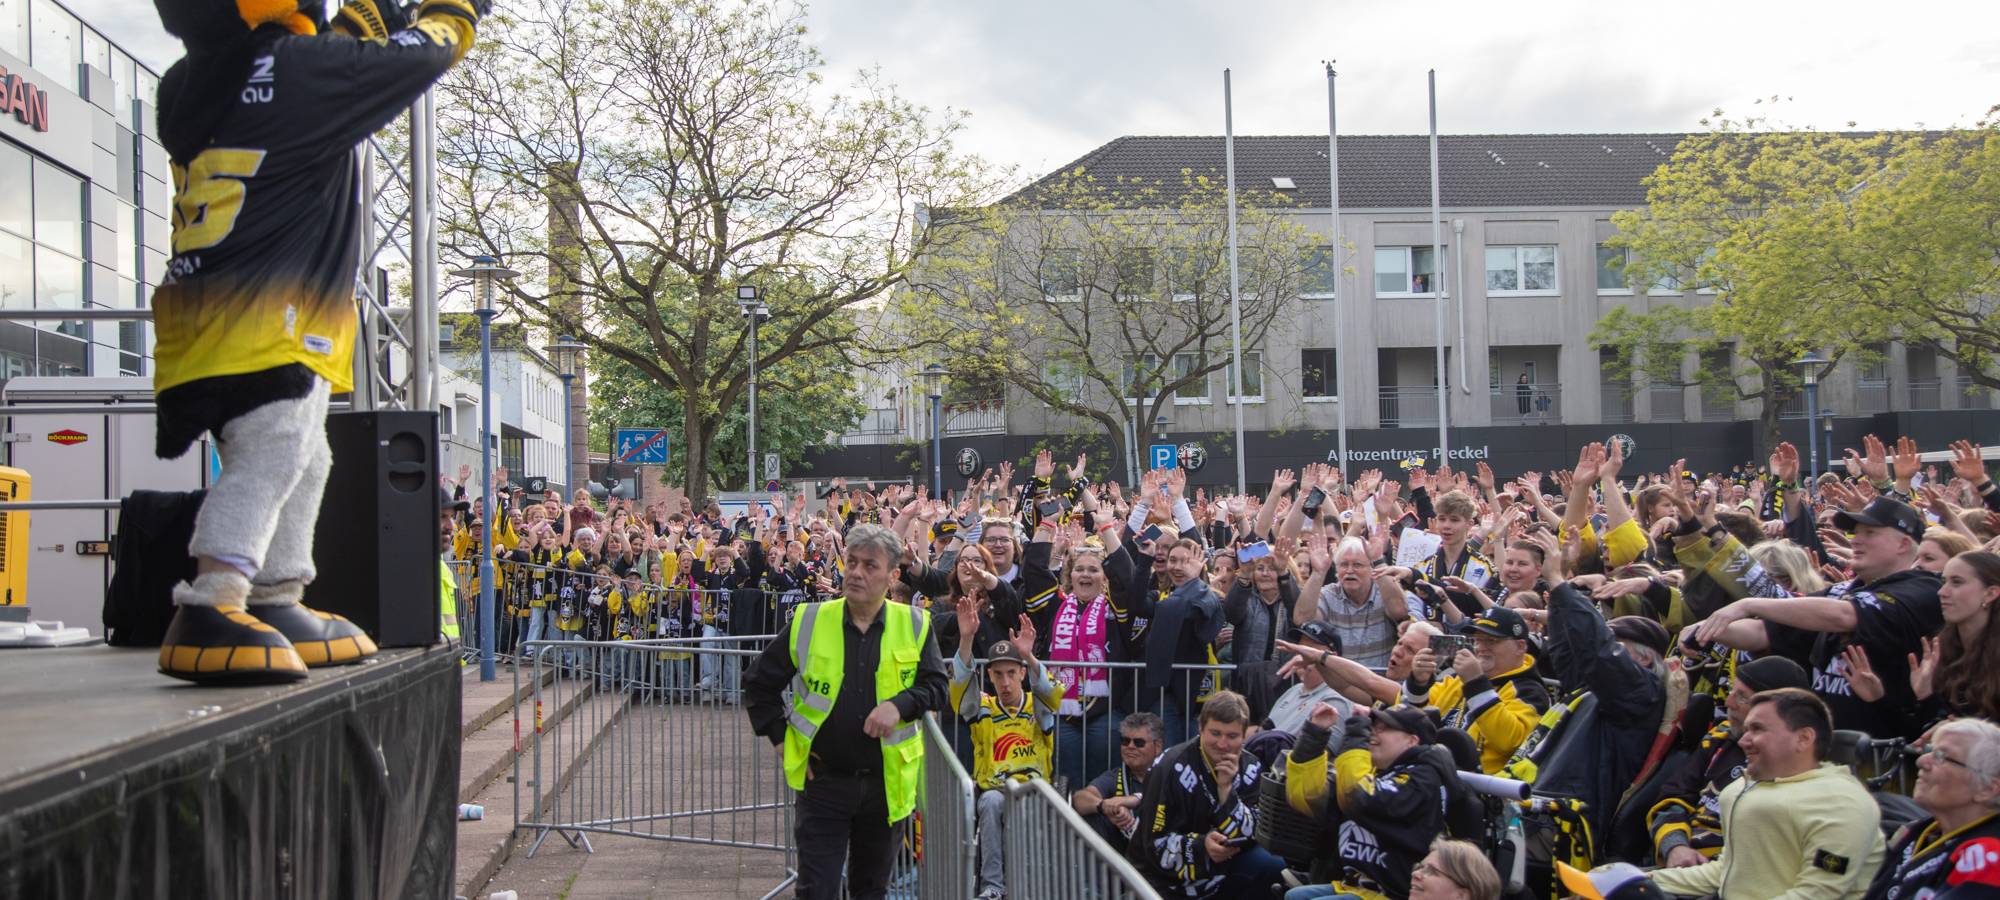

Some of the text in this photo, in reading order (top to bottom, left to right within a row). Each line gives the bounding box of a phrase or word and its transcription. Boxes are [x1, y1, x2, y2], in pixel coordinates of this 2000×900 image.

[1157, 448, 1170, 468] P
[1328, 446, 1488, 461] Atozentru Peckel
[1013, 745, 1037, 759] SWK
[1343, 842, 1388, 868] SWK
